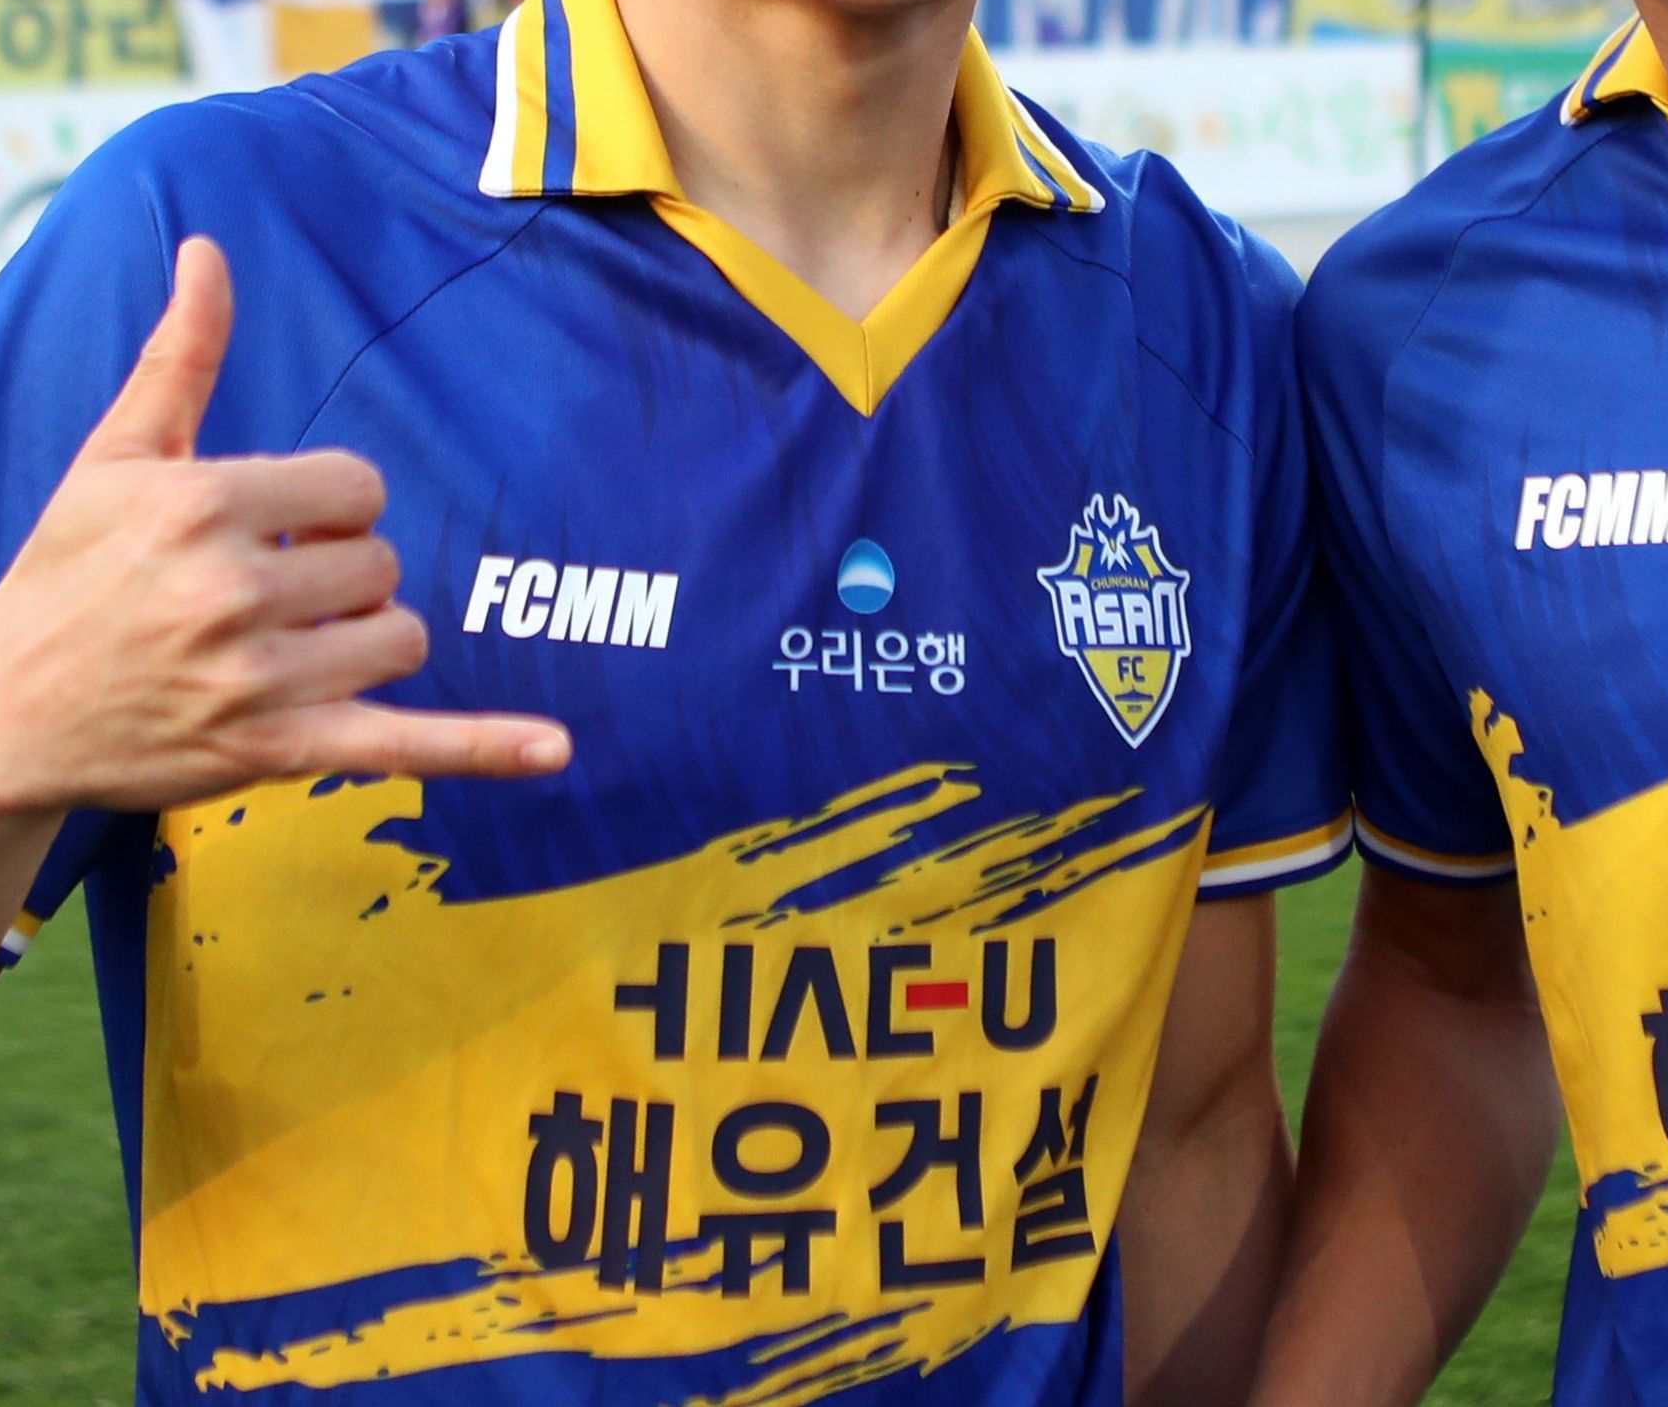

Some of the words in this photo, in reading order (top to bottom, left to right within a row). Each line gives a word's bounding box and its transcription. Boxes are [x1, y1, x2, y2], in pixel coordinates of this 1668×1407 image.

[463, 556, 678, 648] FCMM
[1055, 581, 1182, 645] ASAN
[1090, 575, 1150, 591] CHUNGNAM
[772, 626, 966, 695] 우리은행
[1117, 655, 1146, 683] FC
[523, 1073, 1099, 1299] 해유건설
